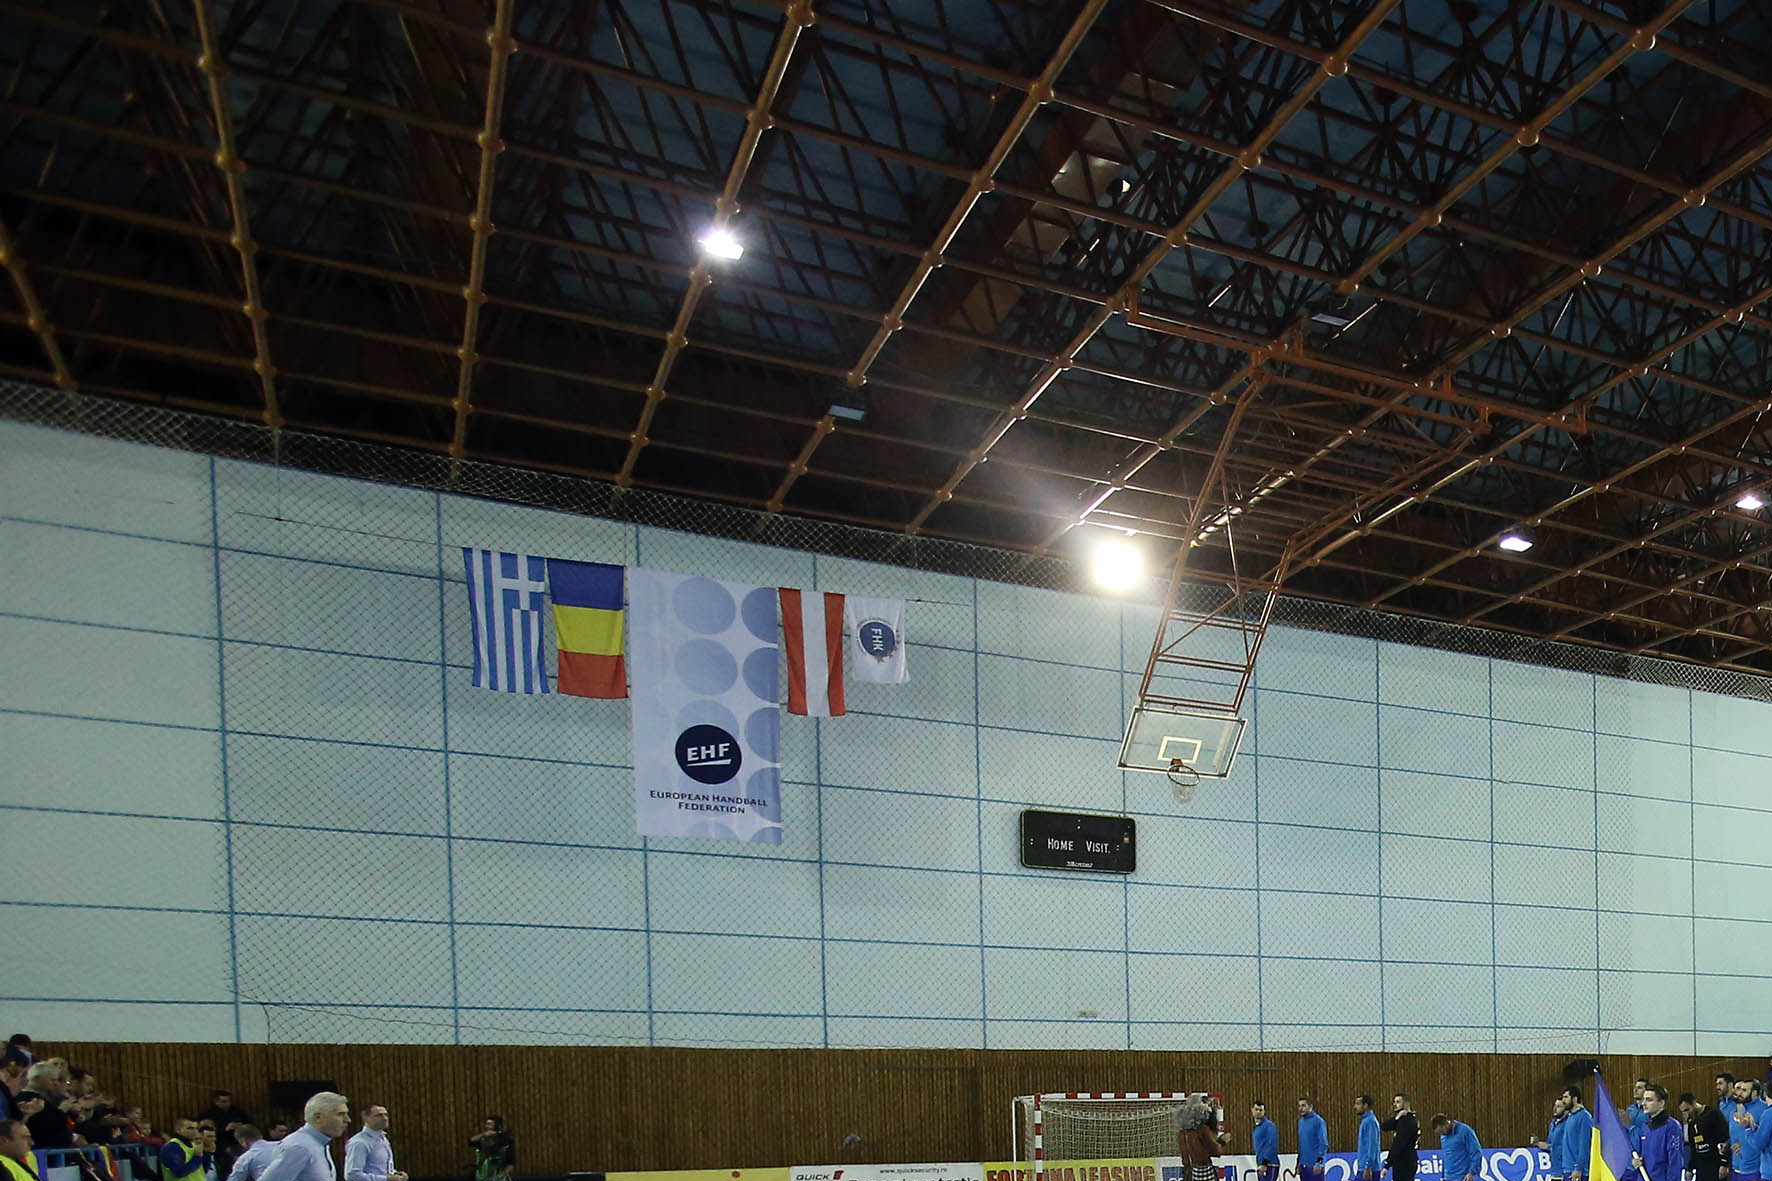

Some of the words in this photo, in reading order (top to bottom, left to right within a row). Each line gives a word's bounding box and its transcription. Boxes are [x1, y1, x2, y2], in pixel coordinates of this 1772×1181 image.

[687, 742, 731, 761] EHF
[650, 790, 710, 801] EUROPEAN
[712, 794, 768, 807] HANDBALL
[678, 802, 745, 814] FEDERATION
[1047, 837, 1074, 851] HOME
